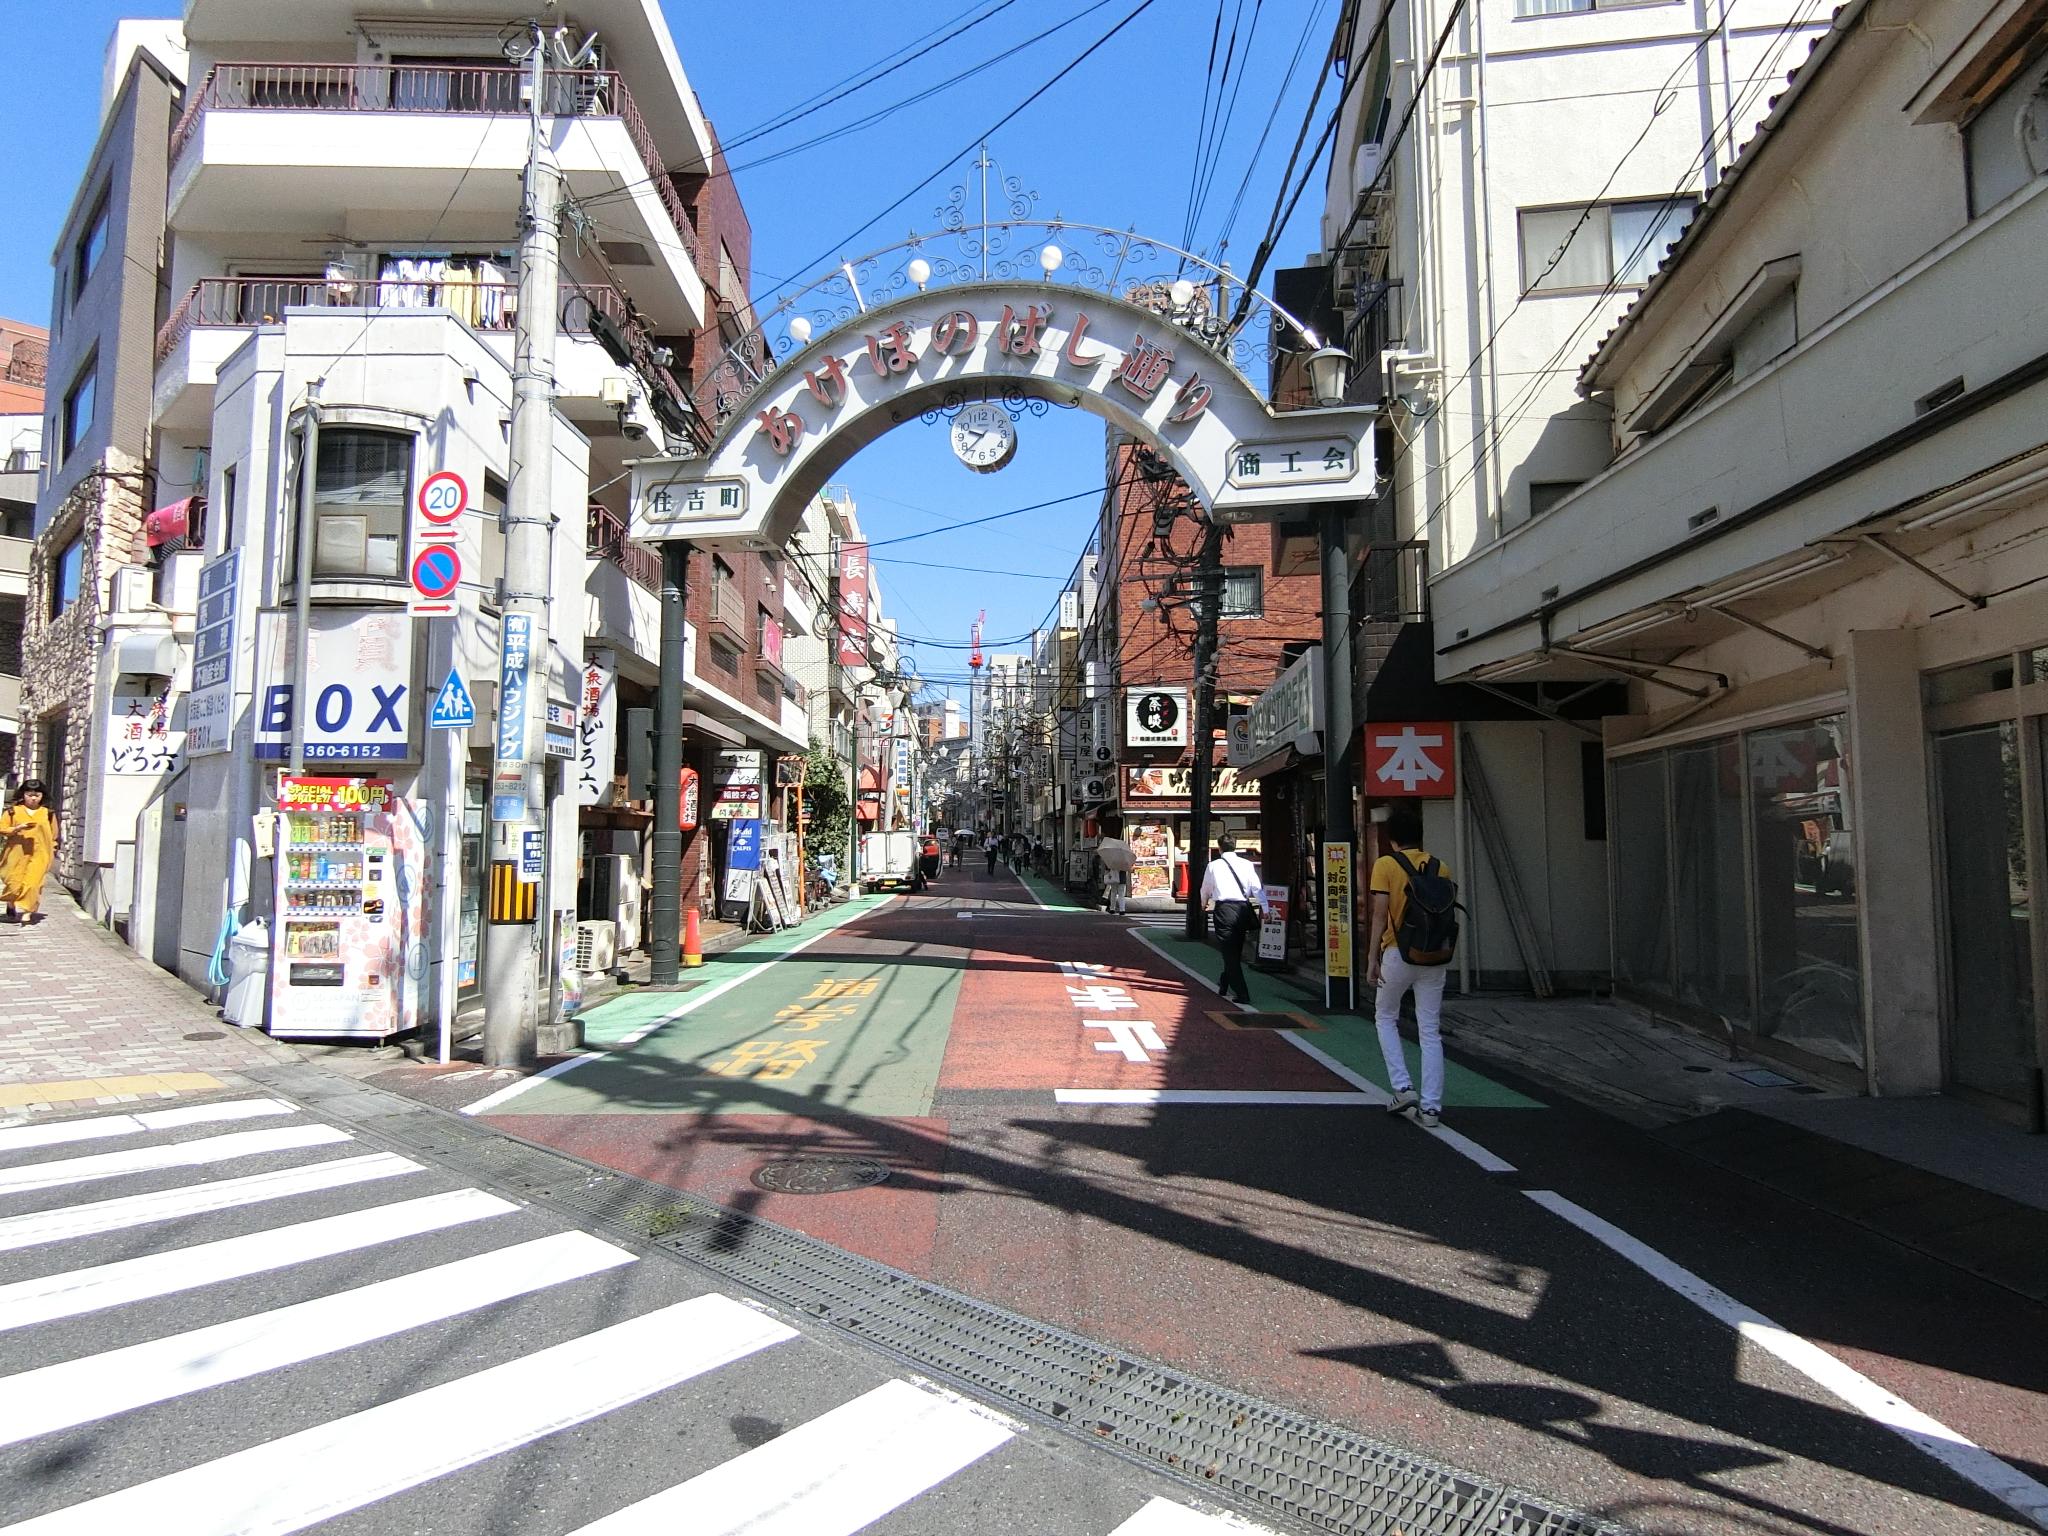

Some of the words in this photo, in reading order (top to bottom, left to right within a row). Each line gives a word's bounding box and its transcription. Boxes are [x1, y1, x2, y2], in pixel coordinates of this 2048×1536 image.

[756, 303, 1212, 456] あけぼのばし通り
[968, 413, 976, 423] 11
[978, 411, 988, 421] 12
[997, 420, 1005, 429] 2
[960, 422, 970, 431] 10
[1000, 430, 1008, 439] 3
[957, 432, 965, 442] 9
[997, 440, 1004, 449] 4
[970, 449, 976, 459] 7
[978, 452, 986, 461] 6
[989, 448, 996, 457] 5
[1237, 446, 1346, 477] 商工会
[429, 486, 458, 509] 20
[653, 487, 740, 514] 住吉町
[584, 652, 605, 718] 大衆酒場
[260, 683, 408, 734] BOX
[124, 722, 169, 742] 酒場
[1080, 715, 1092, 757] 白木屋
[111, 745, 179, 773] どろ六
[579, 719, 604, 796] どろ六
[1375, 726, 1444, 791] 本
[288, 784, 334, 796] SPECIAL
[338, 785, 386, 805] 100円
[1056, 960, 1168, 1063] 止まれ
[709, 977, 882, 1081] 通学路
